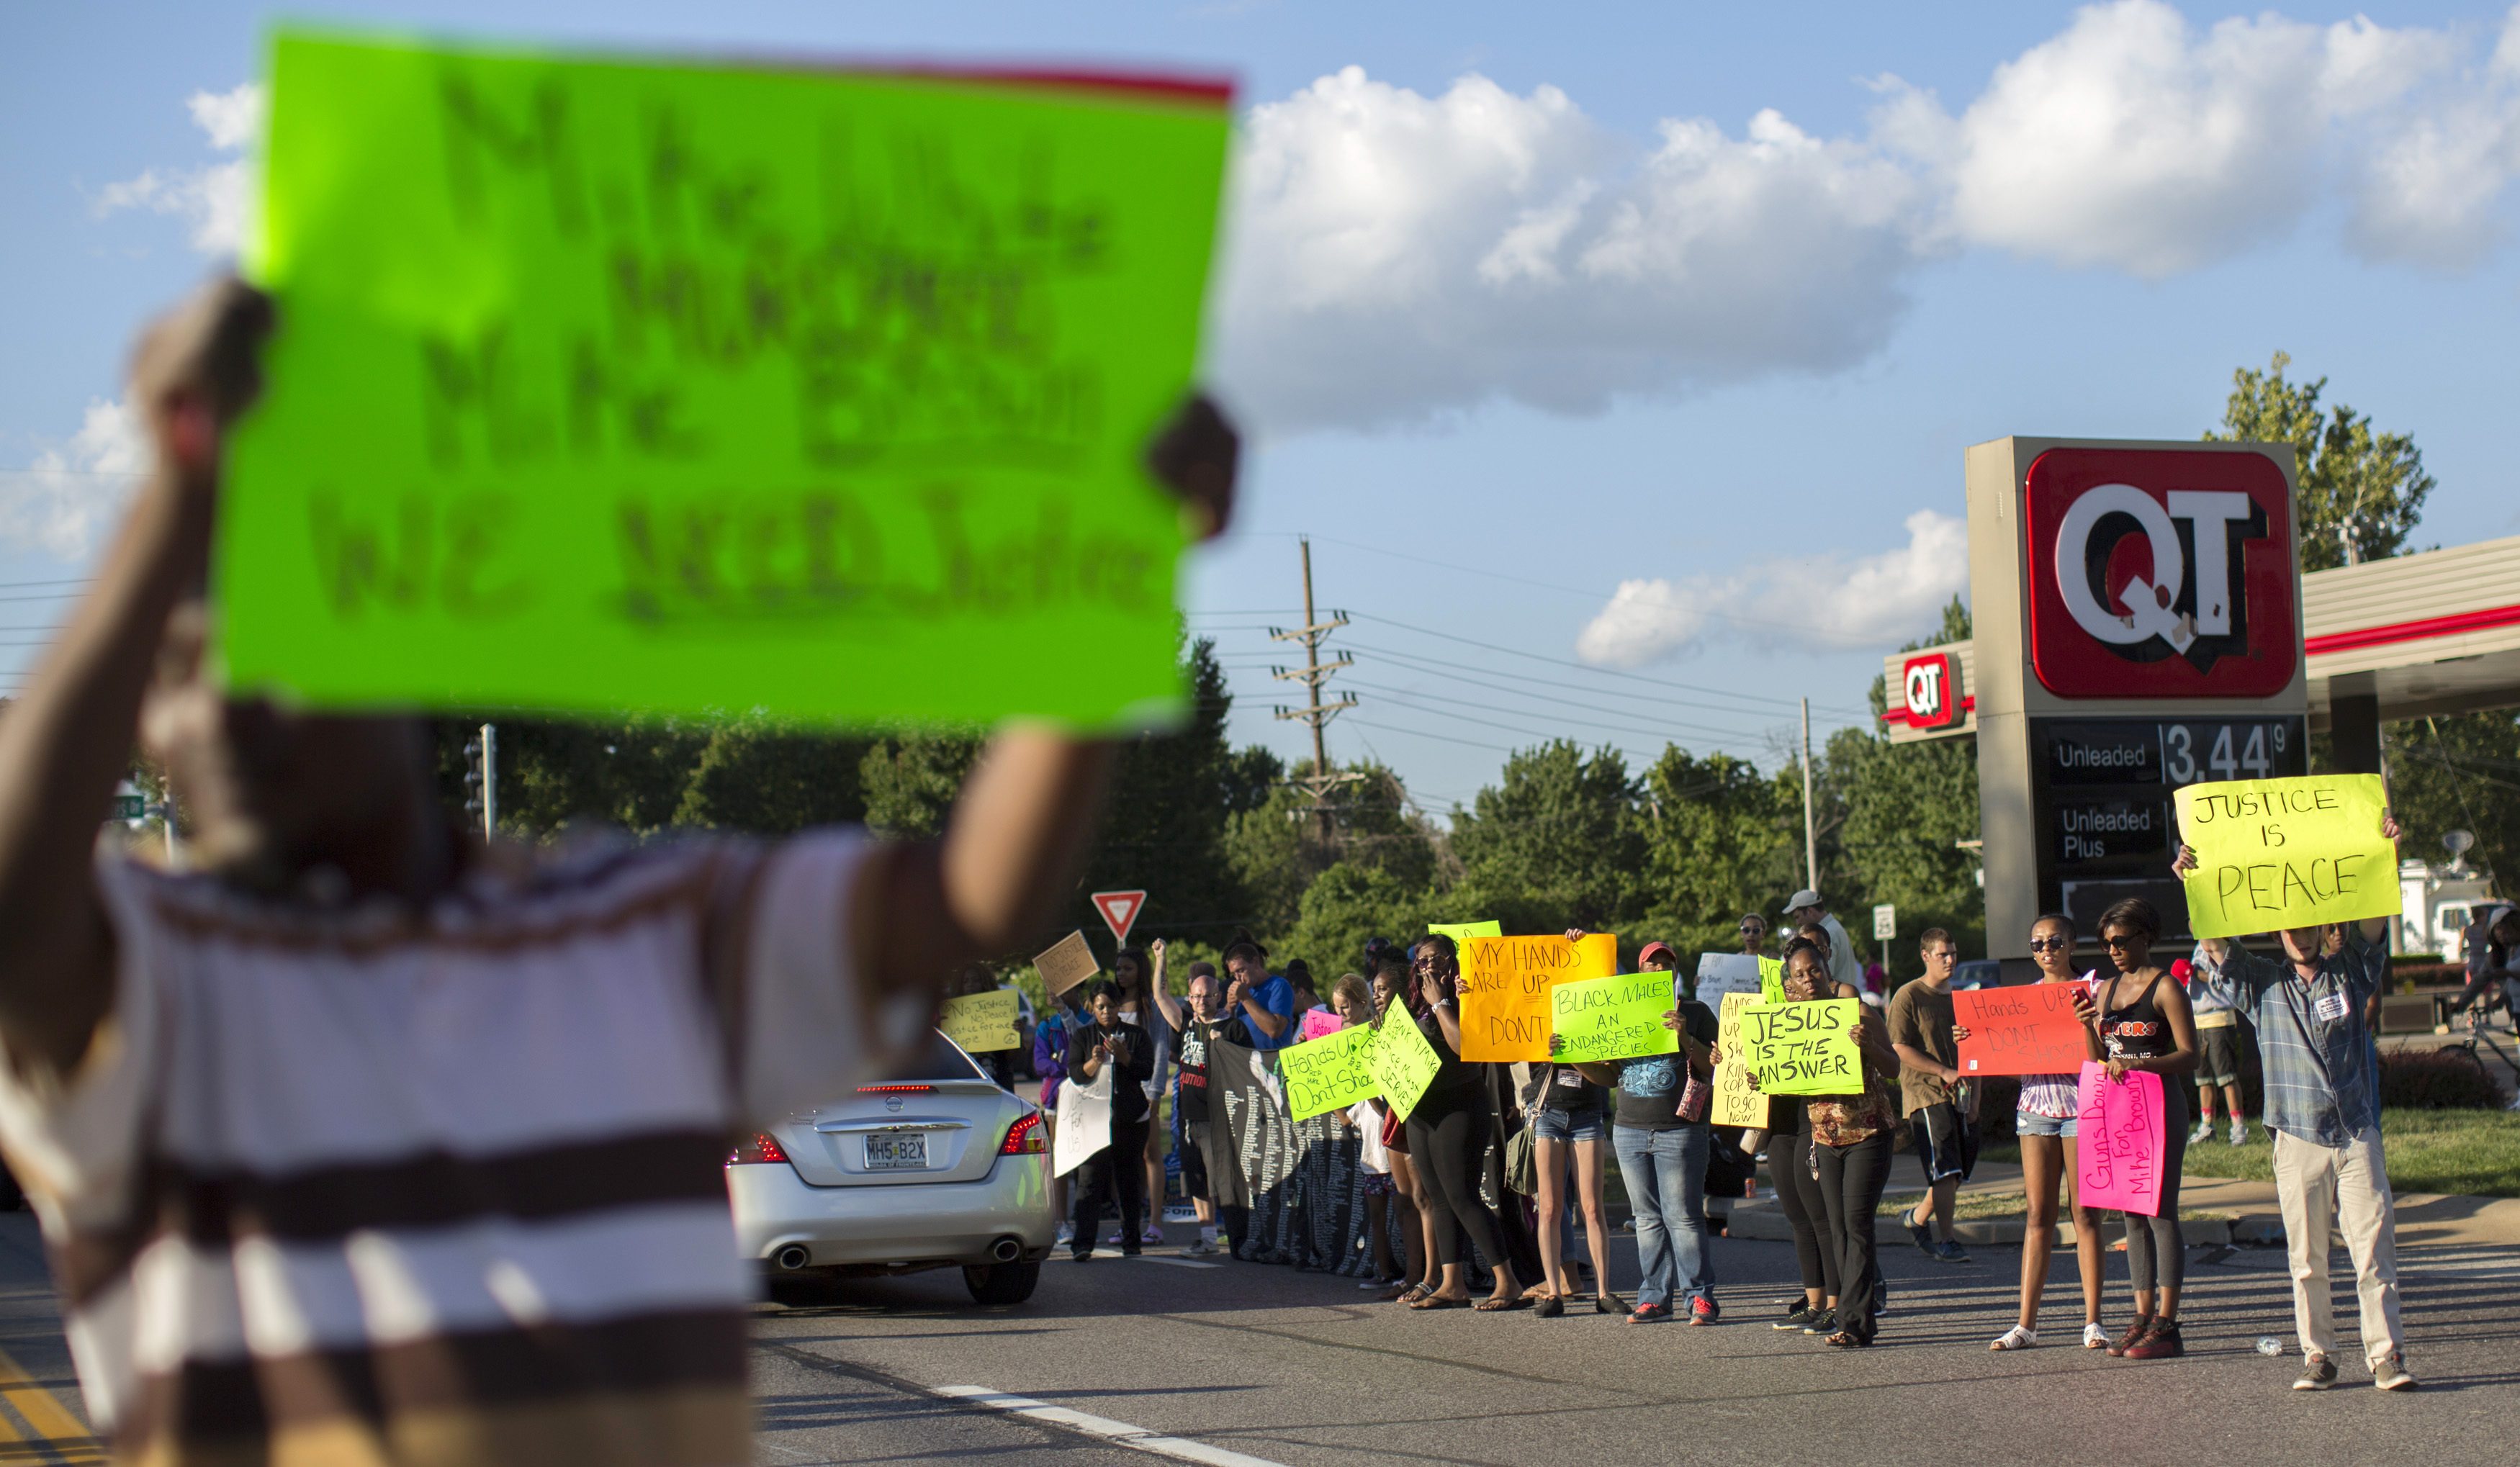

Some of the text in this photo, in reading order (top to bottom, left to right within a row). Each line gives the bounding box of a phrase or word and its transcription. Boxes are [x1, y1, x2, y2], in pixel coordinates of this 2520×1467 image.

[2055, 483, 2251, 656] QT
[1906, 662, 1940, 715] QT
[2059, 743, 2146, 767] Unleaded
[2063, 808, 2150, 833] Unleaded
[2195, 789, 2339, 823] JUSTICE
[2064, 836, 2105, 858] Plus
[2262, 823, 2285, 847] IS
[2218, 854, 2364, 922] PEACE
[1469, 941, 1581, 971] MY HANDS
[1471, 971, 1550, 994] ARE UP
[950, 1003, 971, 1019] No
[1554, 980, 1671, 1015] BLACK MALES
[1970, 985, 2069, 1020] Hands UP
[1490, 1015, 1547, 1046] DONT
[1596, 1013, 1619, 1030] AN
[1724, 1022, 1740, 1038] UP
[1745, 1005, 1841, 1045] JESUS
[1586, 1042, 1653, 1061] SPECIES
[1757, 1037, 1832, 1061] IS THE
[1985, 1023, 2040, 1052] DONT
[1286, 1044, 1336, 1075] Hands
[2017, 1041, 2087, 1066] SHOOT
[1758, 1054, 1851, 1085] ANSWER
[2123, 1078, 2146, 1133] Brown
[2081, 1073, 2111, 1190] Guns Down
[2111, 1129, 2132, 1158] For
[866, 1141, 925, 1160] MH5 B2X
